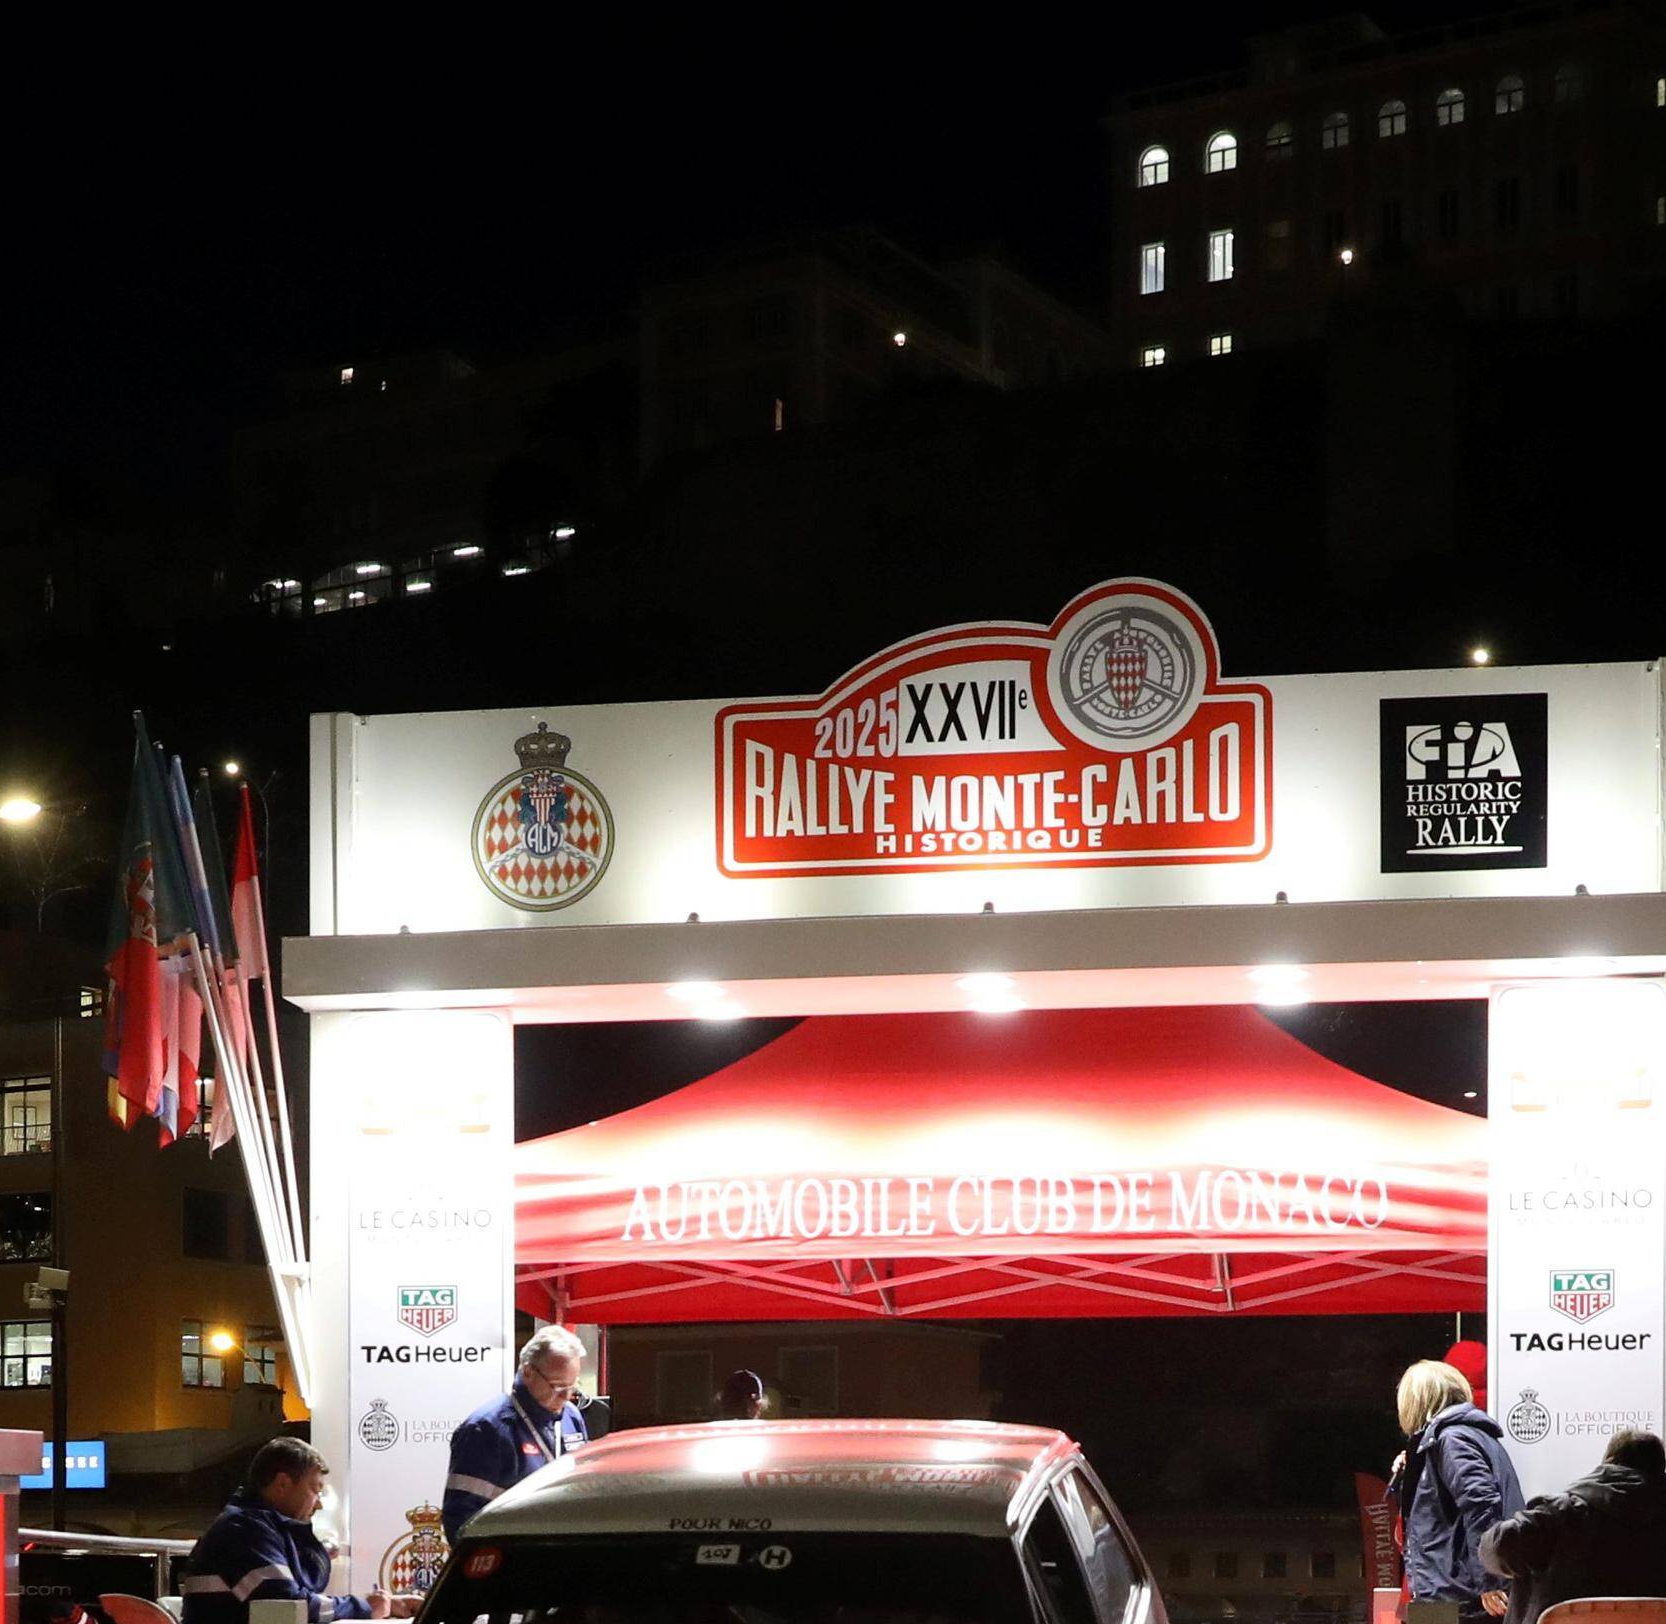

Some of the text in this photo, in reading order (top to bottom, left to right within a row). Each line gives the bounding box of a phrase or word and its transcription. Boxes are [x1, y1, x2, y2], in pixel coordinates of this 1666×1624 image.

[814, 685, 899, 759] 2025
[744, 737, 896, 838] RALLYE
[1405, 781, 1522, 803] HISTORIC
[1406, 801, 1522, 817] REGULARITY
[876, 828, 1103, 853] HISTORIQUE
[1415, 816, 1511, 847] RALLY
[621, 1170, 1390, 1241] AUTOMOBILE CLUB DE MONACO
[1509, 1189, 1653, 1211] LE CASINO
[359, 1208, 493, 1229] LE CASINO
[1553, 1273, 1611, 1291] TAG
[401, 1289, 453, 1306] TAG
[1585, 1410, 1654, 1423] BOUTIQUE
[411, 1431, 454, 1443] OFFIC
[669, 1518, 773, 1530] POUR NICO
[765, 1549, 786, 1565] H
